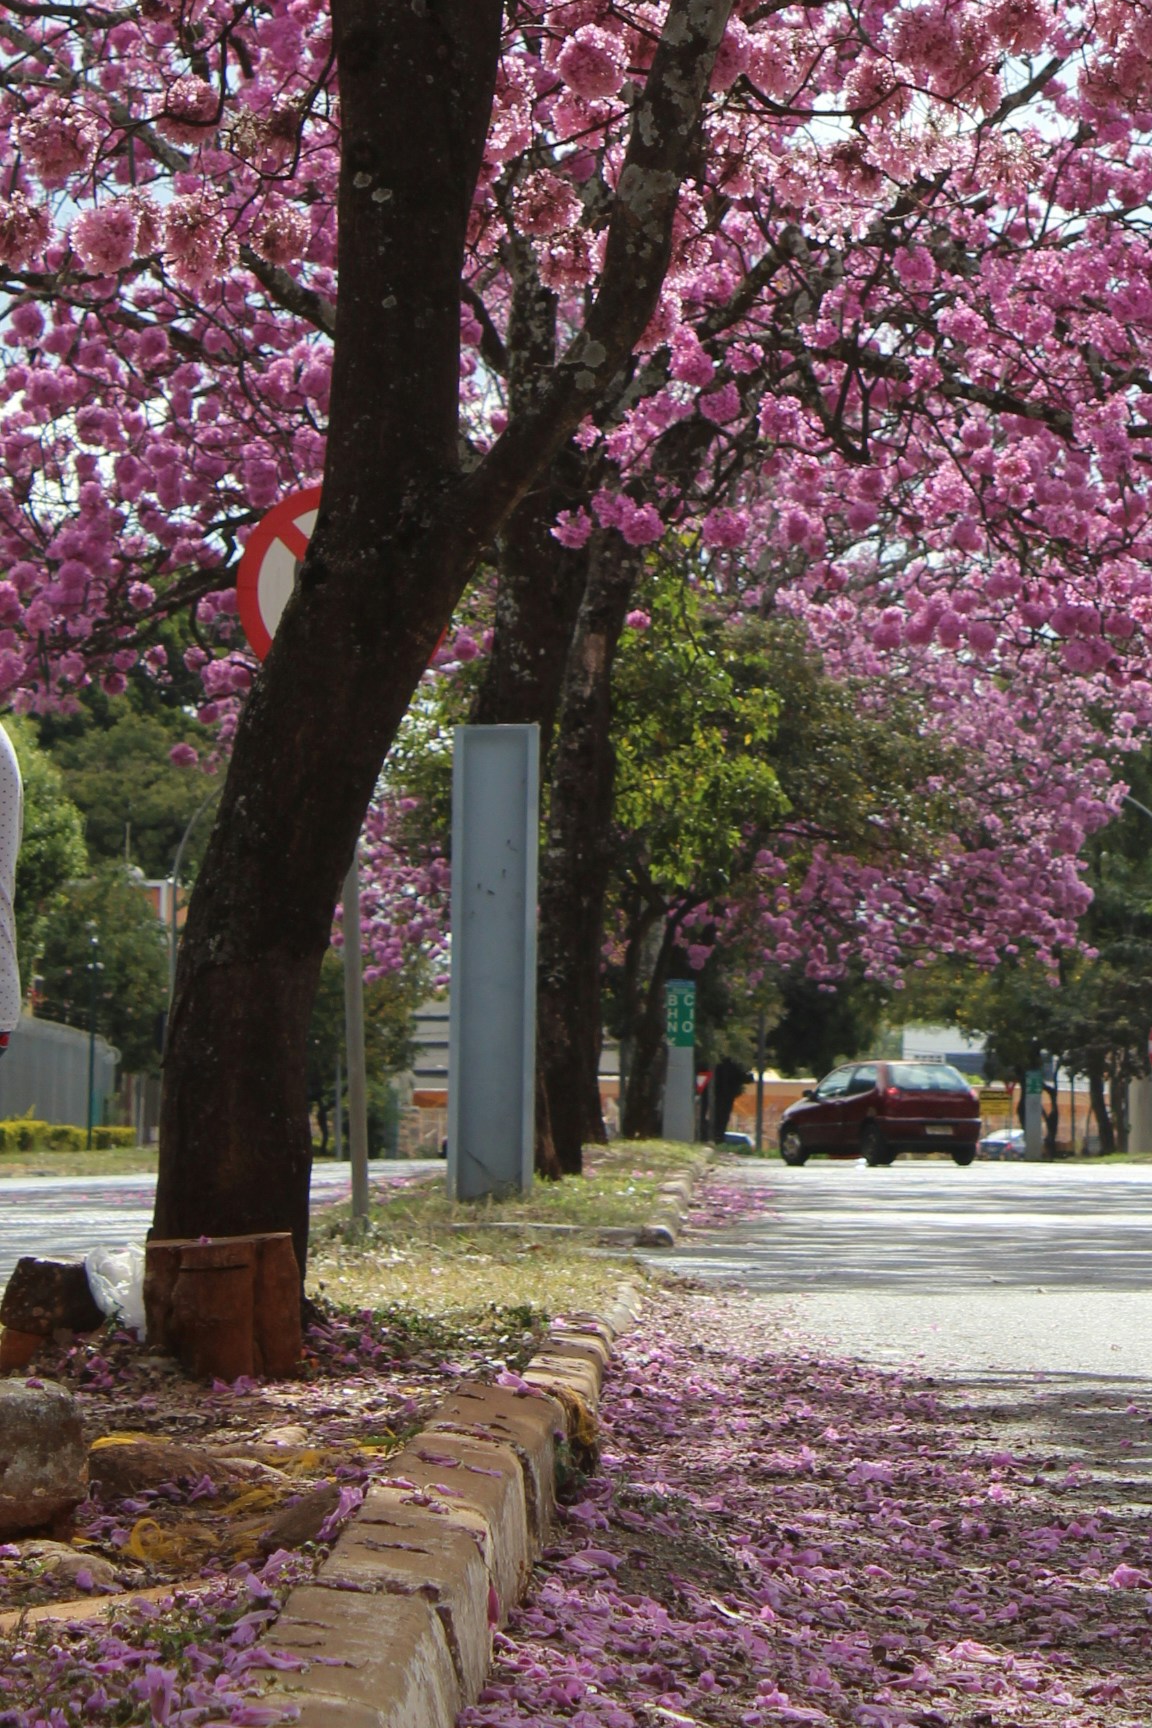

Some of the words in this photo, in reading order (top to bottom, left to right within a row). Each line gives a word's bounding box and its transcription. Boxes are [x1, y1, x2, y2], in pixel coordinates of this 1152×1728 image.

[668, 994, 678, 1006] B
[683, 993, 695, 1006] C
[667, 1008, 678, 1019] H
[667, 1021, 678, 1033] N
[681, 1020, 694, 1033] O
